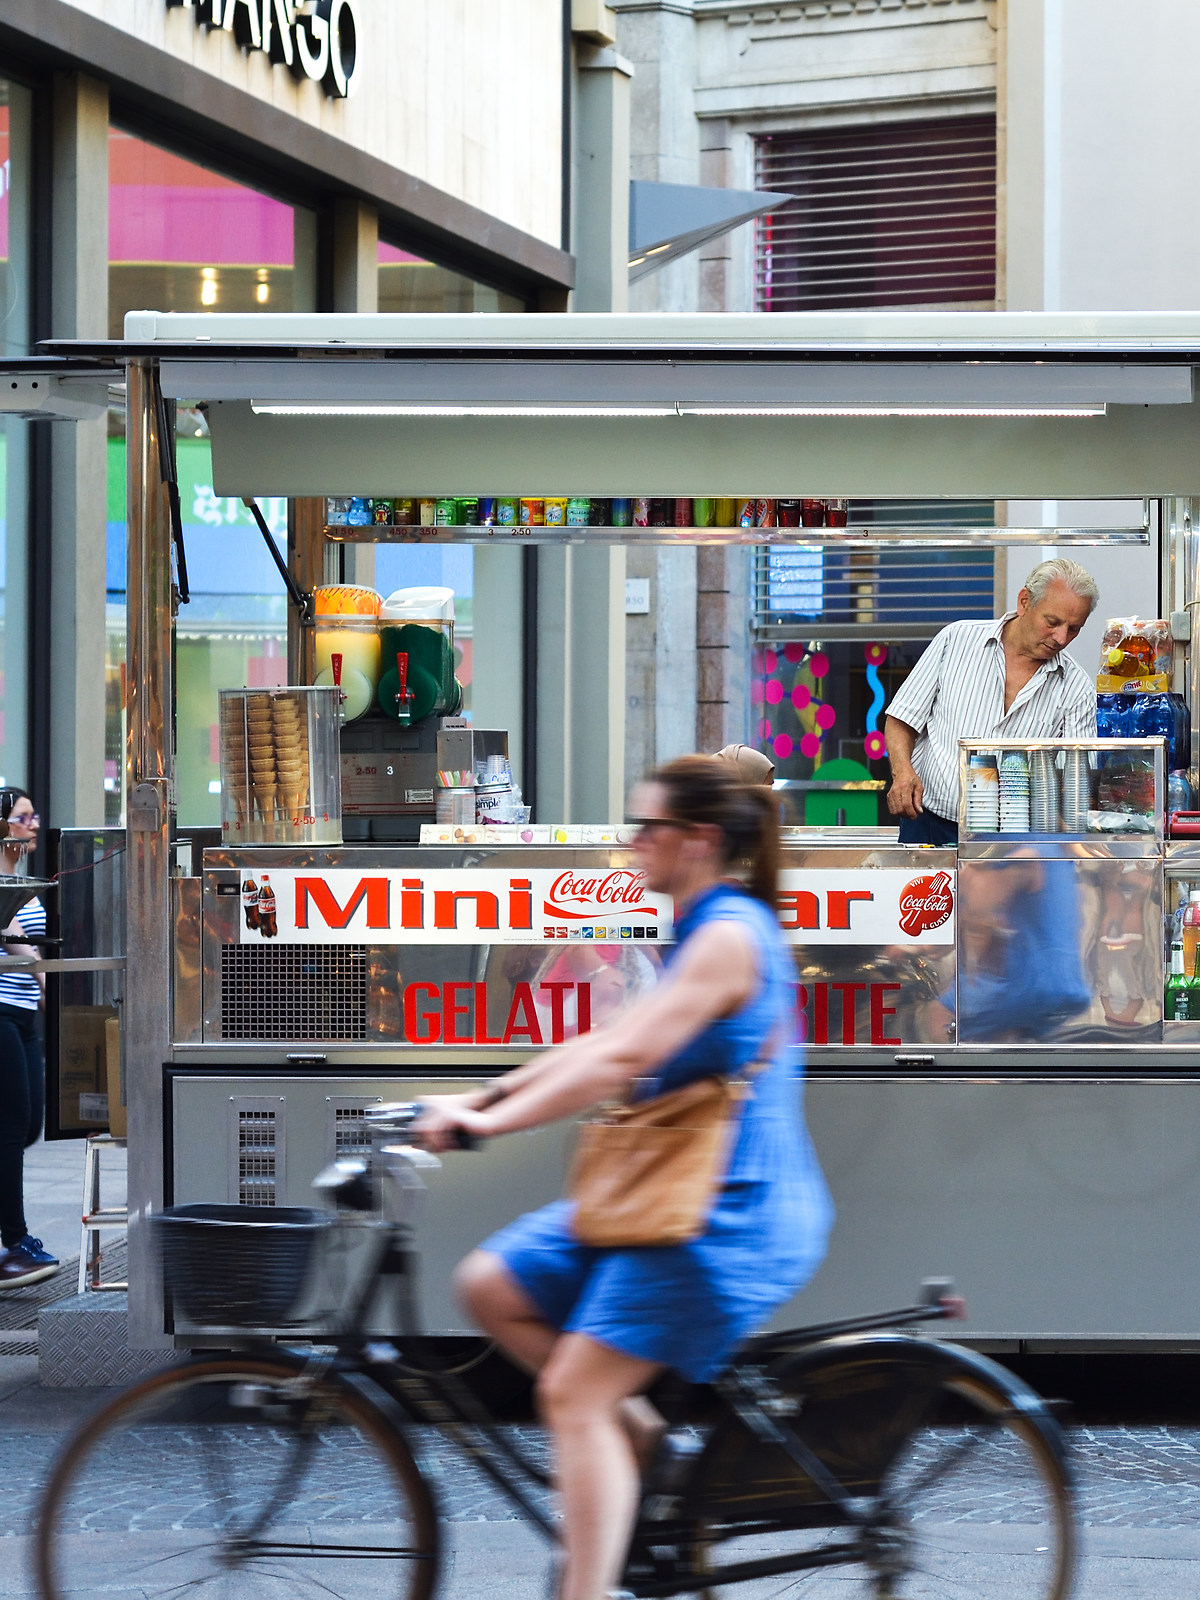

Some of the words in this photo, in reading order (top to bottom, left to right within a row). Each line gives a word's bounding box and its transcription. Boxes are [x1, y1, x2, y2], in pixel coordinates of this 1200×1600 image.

[386, 765, 394, 775] 3
[549, 871, 648, 903] Coca-Cola
[910, 878, 924, 888] VIVI
[294, 877, 533, 930] Mini
[901, 894, 951, 912] Coca-Cola
[930, 912, 949, 929] GUSTO
[403, 982, 591, 1045] GELATI
